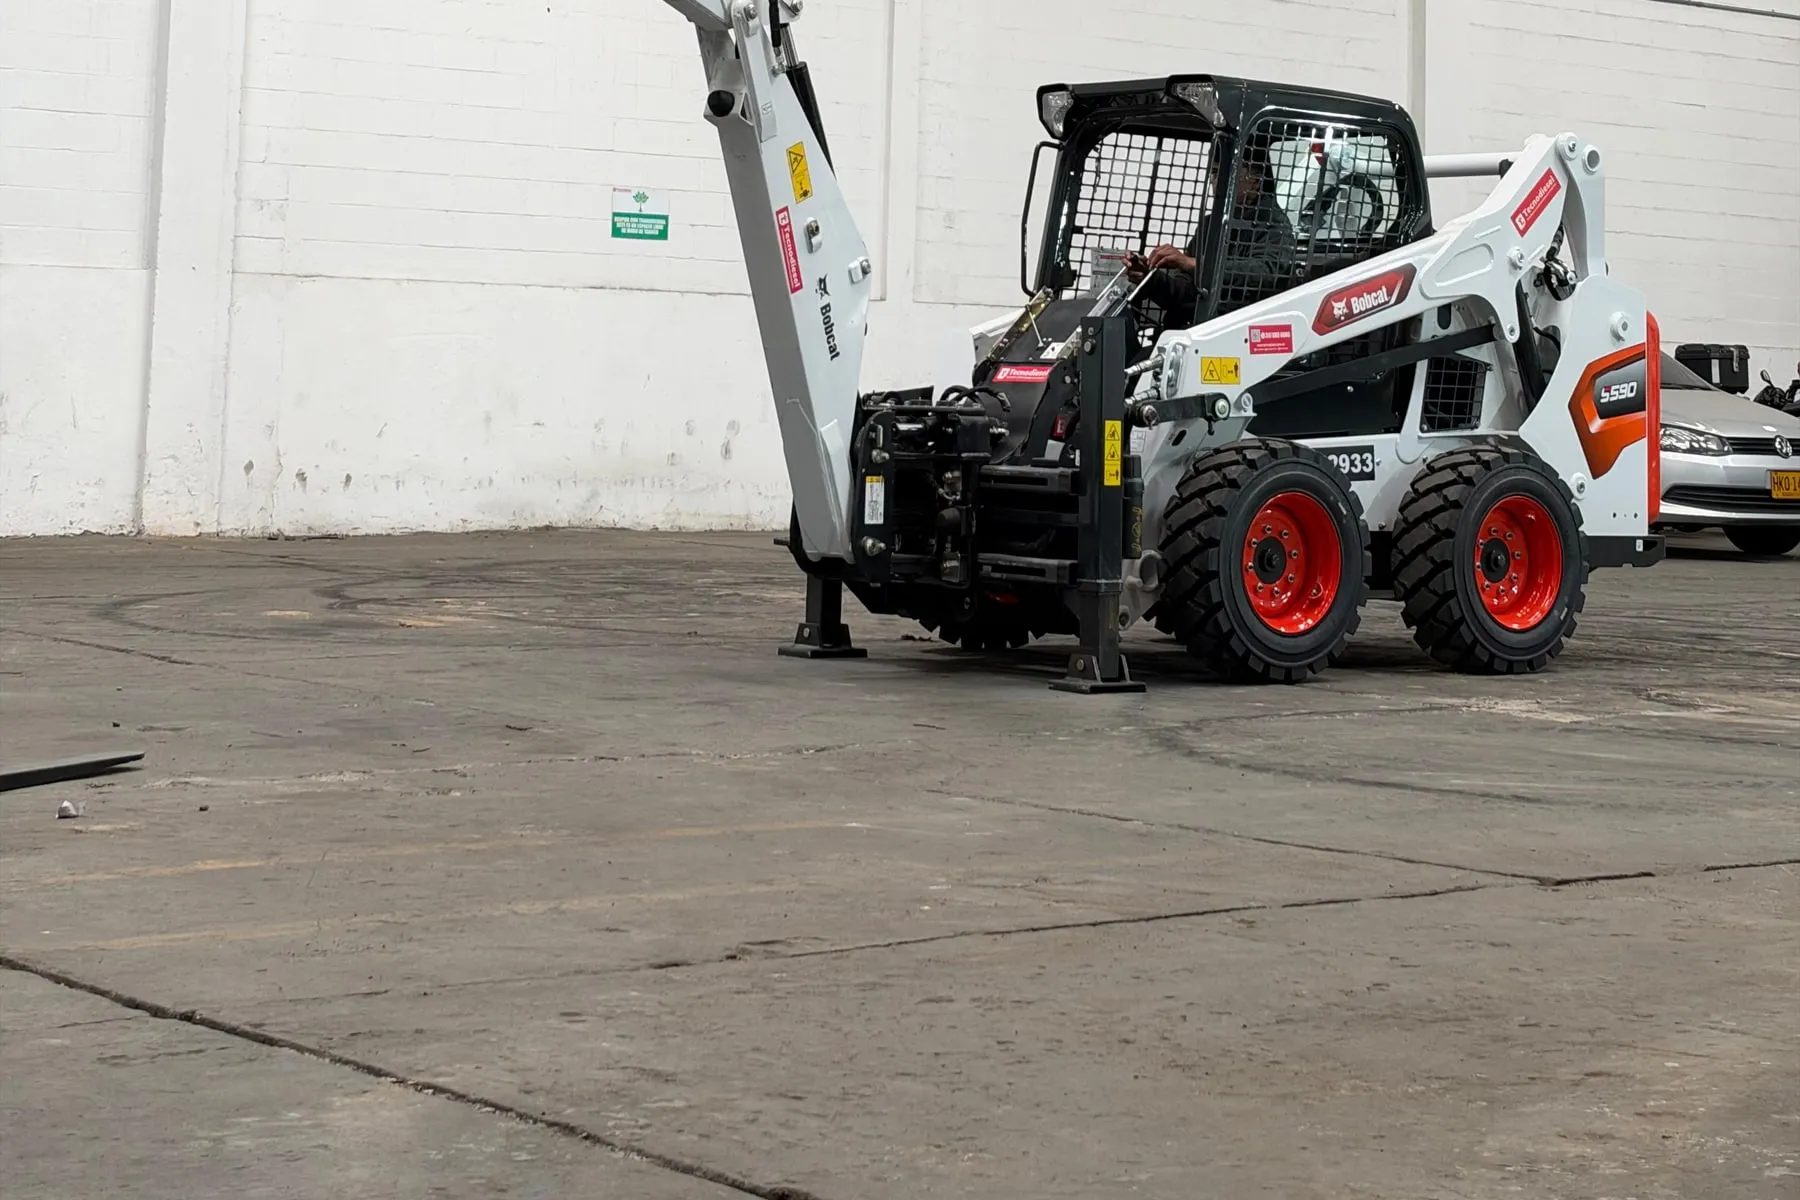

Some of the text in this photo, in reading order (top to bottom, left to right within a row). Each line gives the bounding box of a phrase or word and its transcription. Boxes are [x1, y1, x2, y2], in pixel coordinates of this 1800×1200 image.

[1522, 175, 1555, 217] Tecnodiesel
[1350, 285, 1389, 315] Bobcat
[820, 302, 841, 361] Bobcat
[1600, 381, 1638, 403] S590
